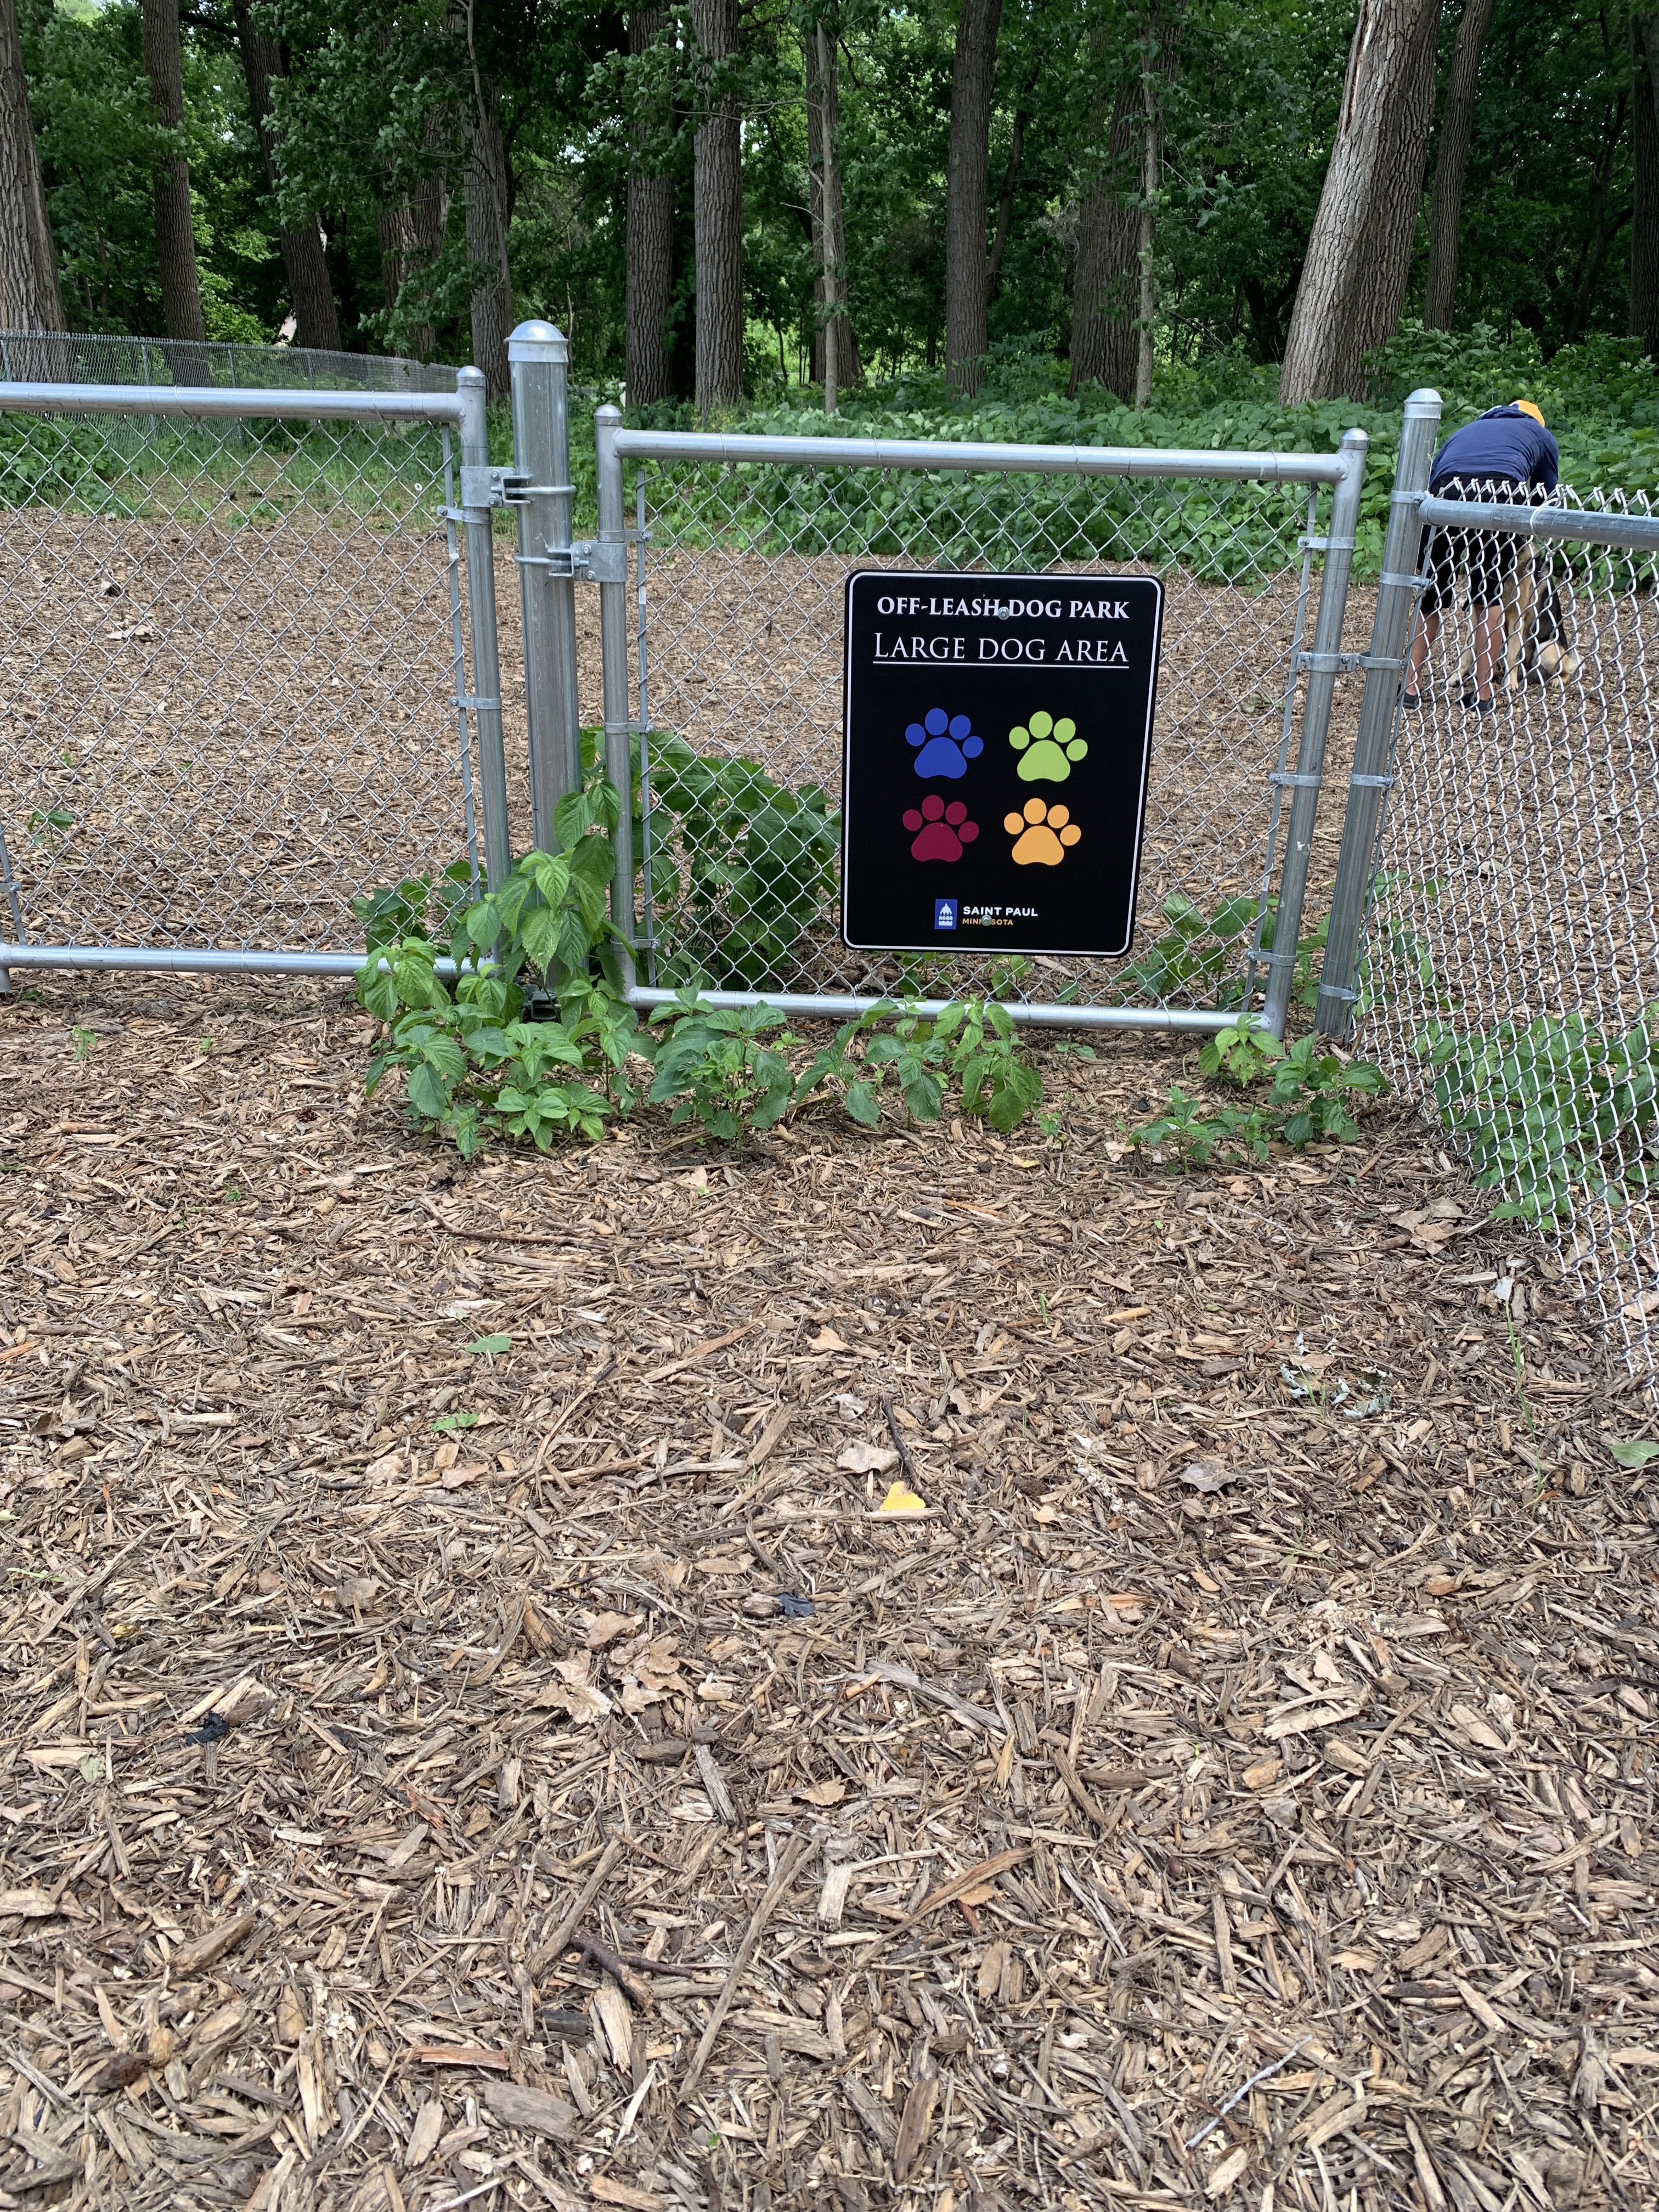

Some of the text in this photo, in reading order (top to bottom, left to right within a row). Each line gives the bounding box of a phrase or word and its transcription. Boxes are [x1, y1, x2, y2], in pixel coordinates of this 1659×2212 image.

[877, 597, 1130, 619] OFF-LEASH DOG PARK
[874, 633, 1129, 663] LARGE DOG AREA
[963, 906, 1038, 917] SAINT PAUL
[962, 918, 1013, 926] MINSOTA
